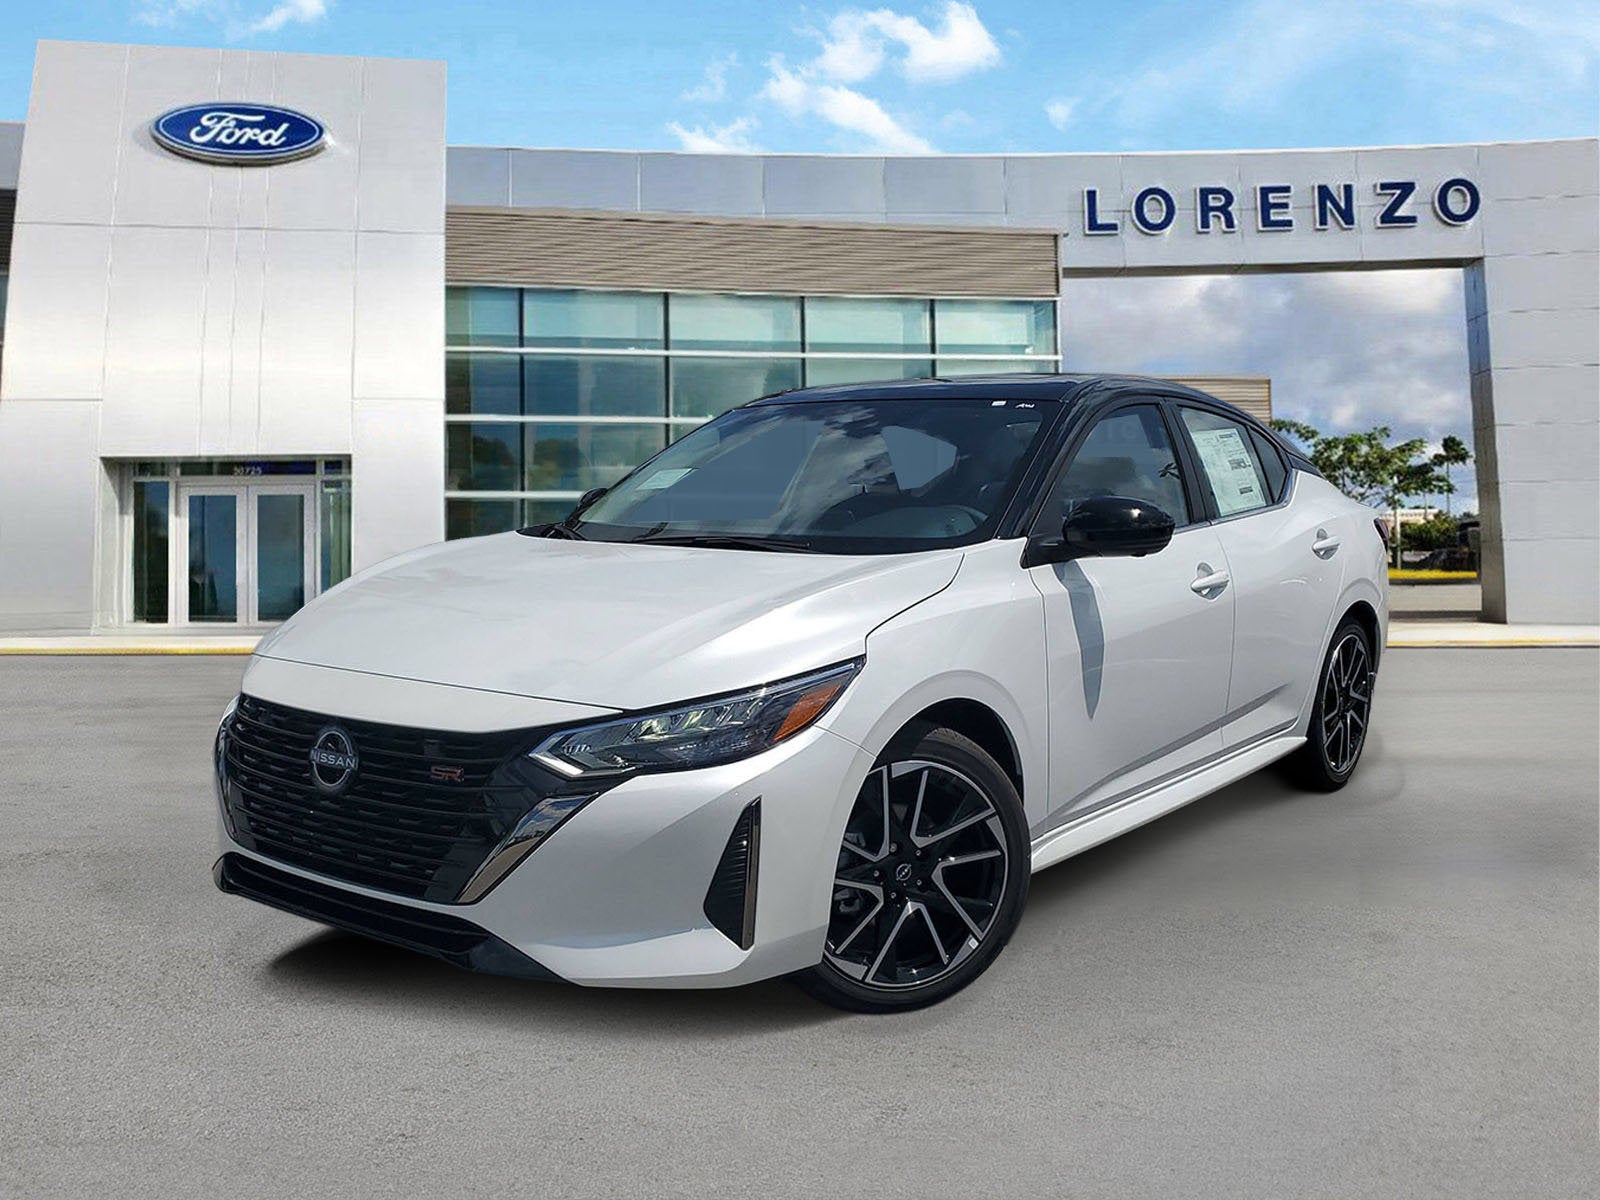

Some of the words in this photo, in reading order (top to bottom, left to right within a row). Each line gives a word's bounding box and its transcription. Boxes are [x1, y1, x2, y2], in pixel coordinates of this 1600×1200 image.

[189, 112, 289, 146] Ford
[1083, 177, 1480, 234] LORENZO
[311, 750, 356, 768] NISSAN
[430, 765, 465, 783] SR
